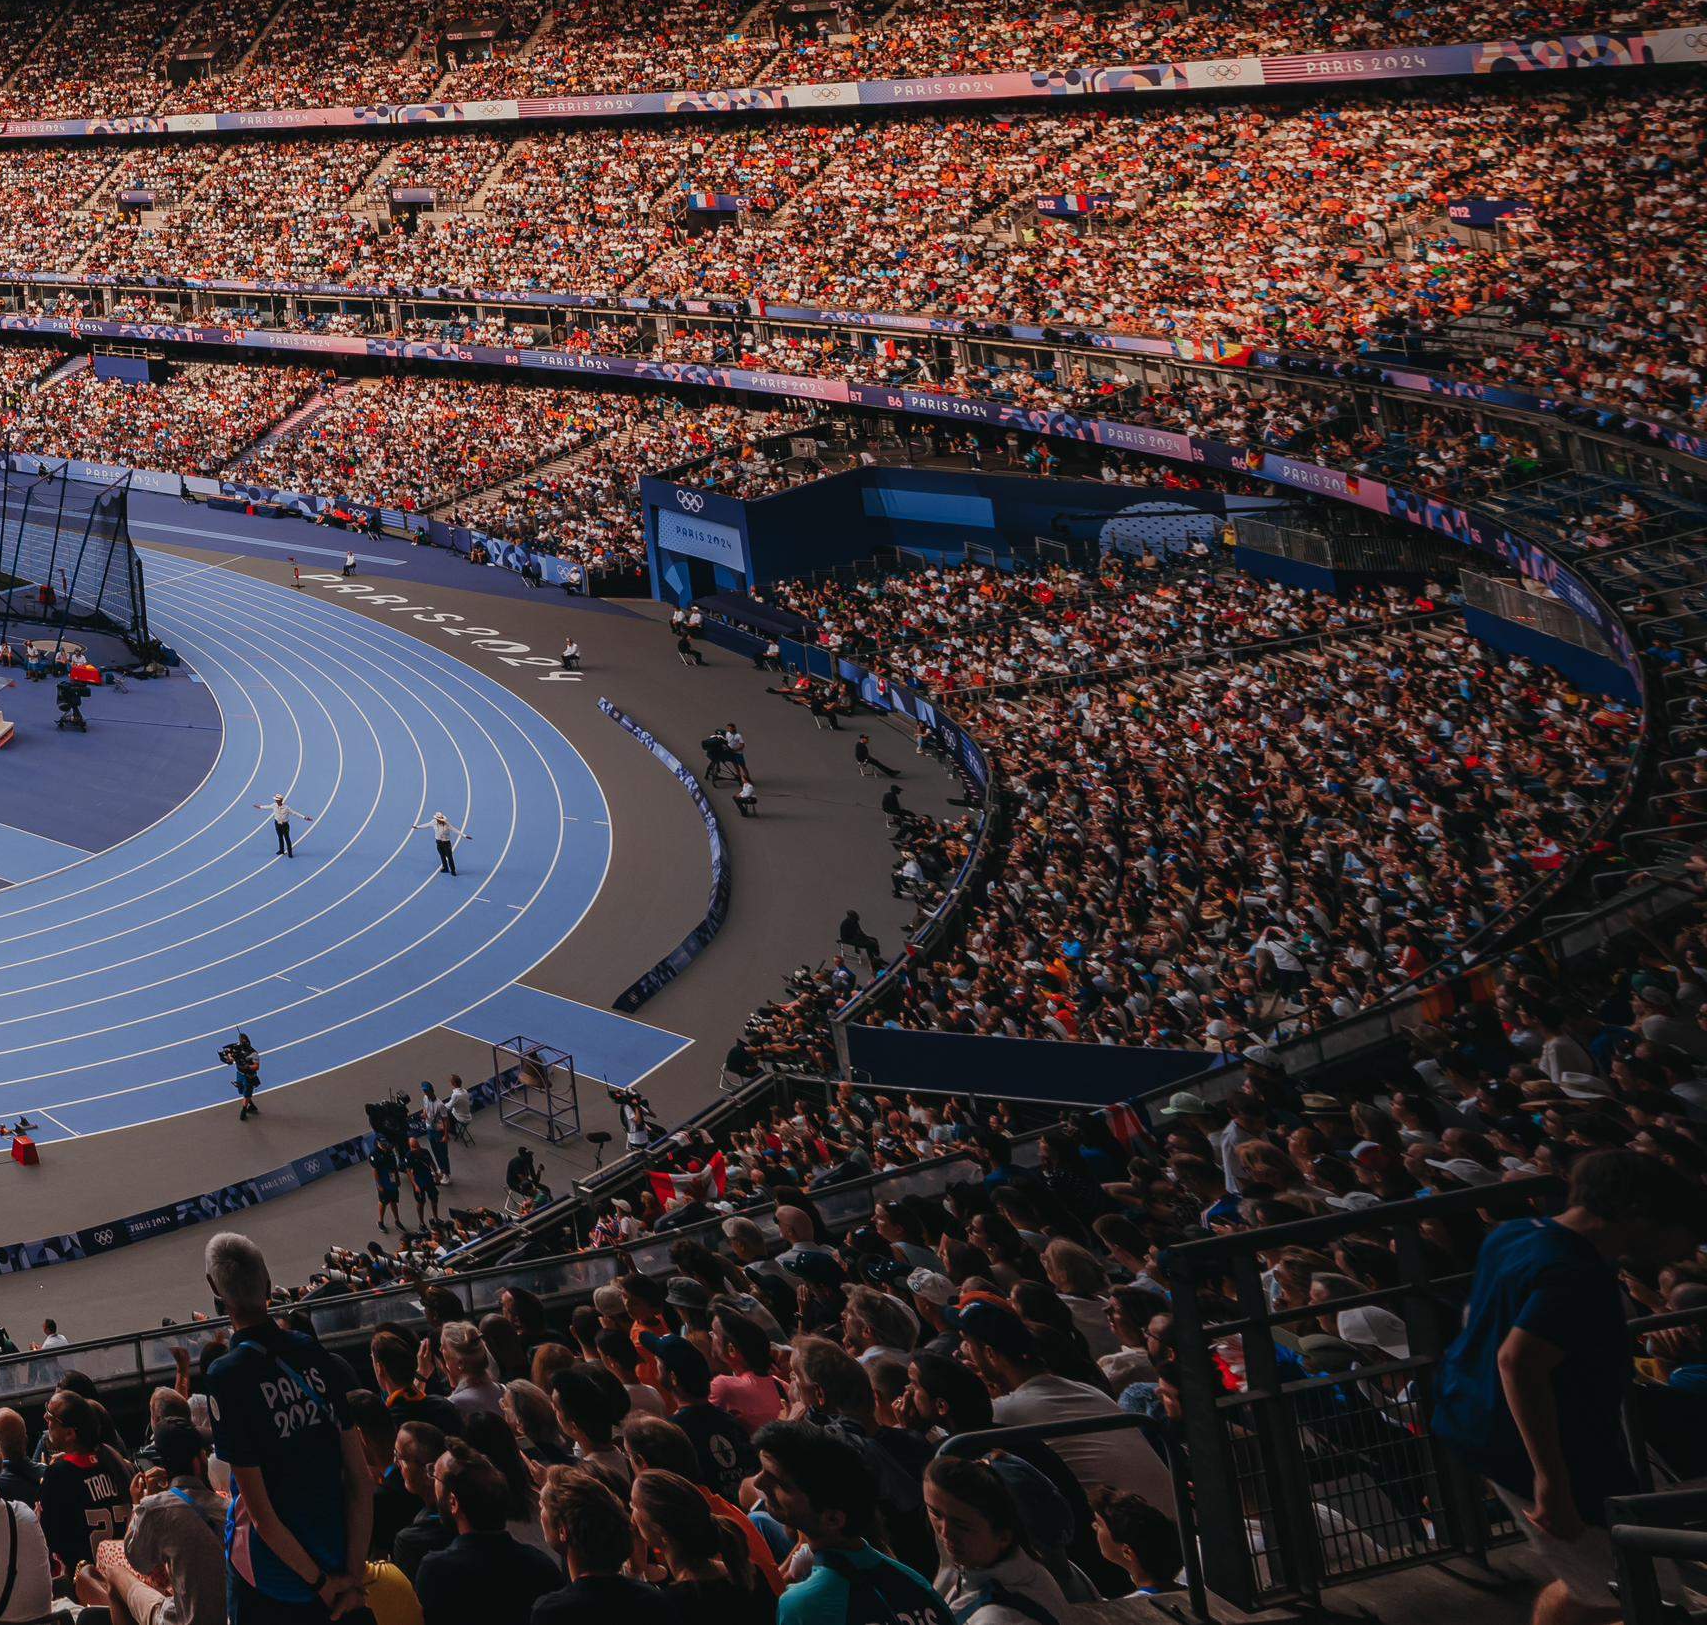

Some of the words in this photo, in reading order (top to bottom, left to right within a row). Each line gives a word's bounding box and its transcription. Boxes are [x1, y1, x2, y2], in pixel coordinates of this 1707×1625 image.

[1307, 60, 1363, 75] PARIS
[1371, 56, 1427, 72] 2024
[893, 84, 943, 97] PARIS
[948, 82, 995, 94] 2024
[548, 101, 590, 113] PARIS
[595, 99, 634, 111] 2024
[240, 115, 274, 126] PARIS
[278, 114, 309, 124] 2024
[9, 124, 36, 134] PARIS
[39, 123, 66, 132] 2024
[79, 324, 103, 333] 2024
[268, 336, 300, 347] PARIS
[302, 338, 331, 348] 2024
[458, 350, 474, 361] C5
[504, 354, 520, 365] B8
[541, 356, 575, 368] PARIS
[751, 376, 787, 390] PARIS
[791, 380, 825, 394] 2024
[849, 390, 862, 403] B7
[888, 395, 903, 408] B6
[911, 396, 948, 412] PARIS
[952, 402, 987, 418] 2024
[1107, 428, 1147, 446] PARIS
[1149, 435, 1181, 452] 2024
[85, 467, 122, 480] PARIS
[1282, 465, 1321, 487] PARIS
[675, 525, 705, 543] PARIS
[706, 533, 732, 551] 2024
[293, 574, 465, 624] PARIS
[439, 626, 585, 683] 2024
[260, 1178, 278, 1192] PARIS
[278, 1172, 296, 1187] 2024
[130, 1219, 152, 1233] PARIS
[152, 1215, 172, 1228] 2024
